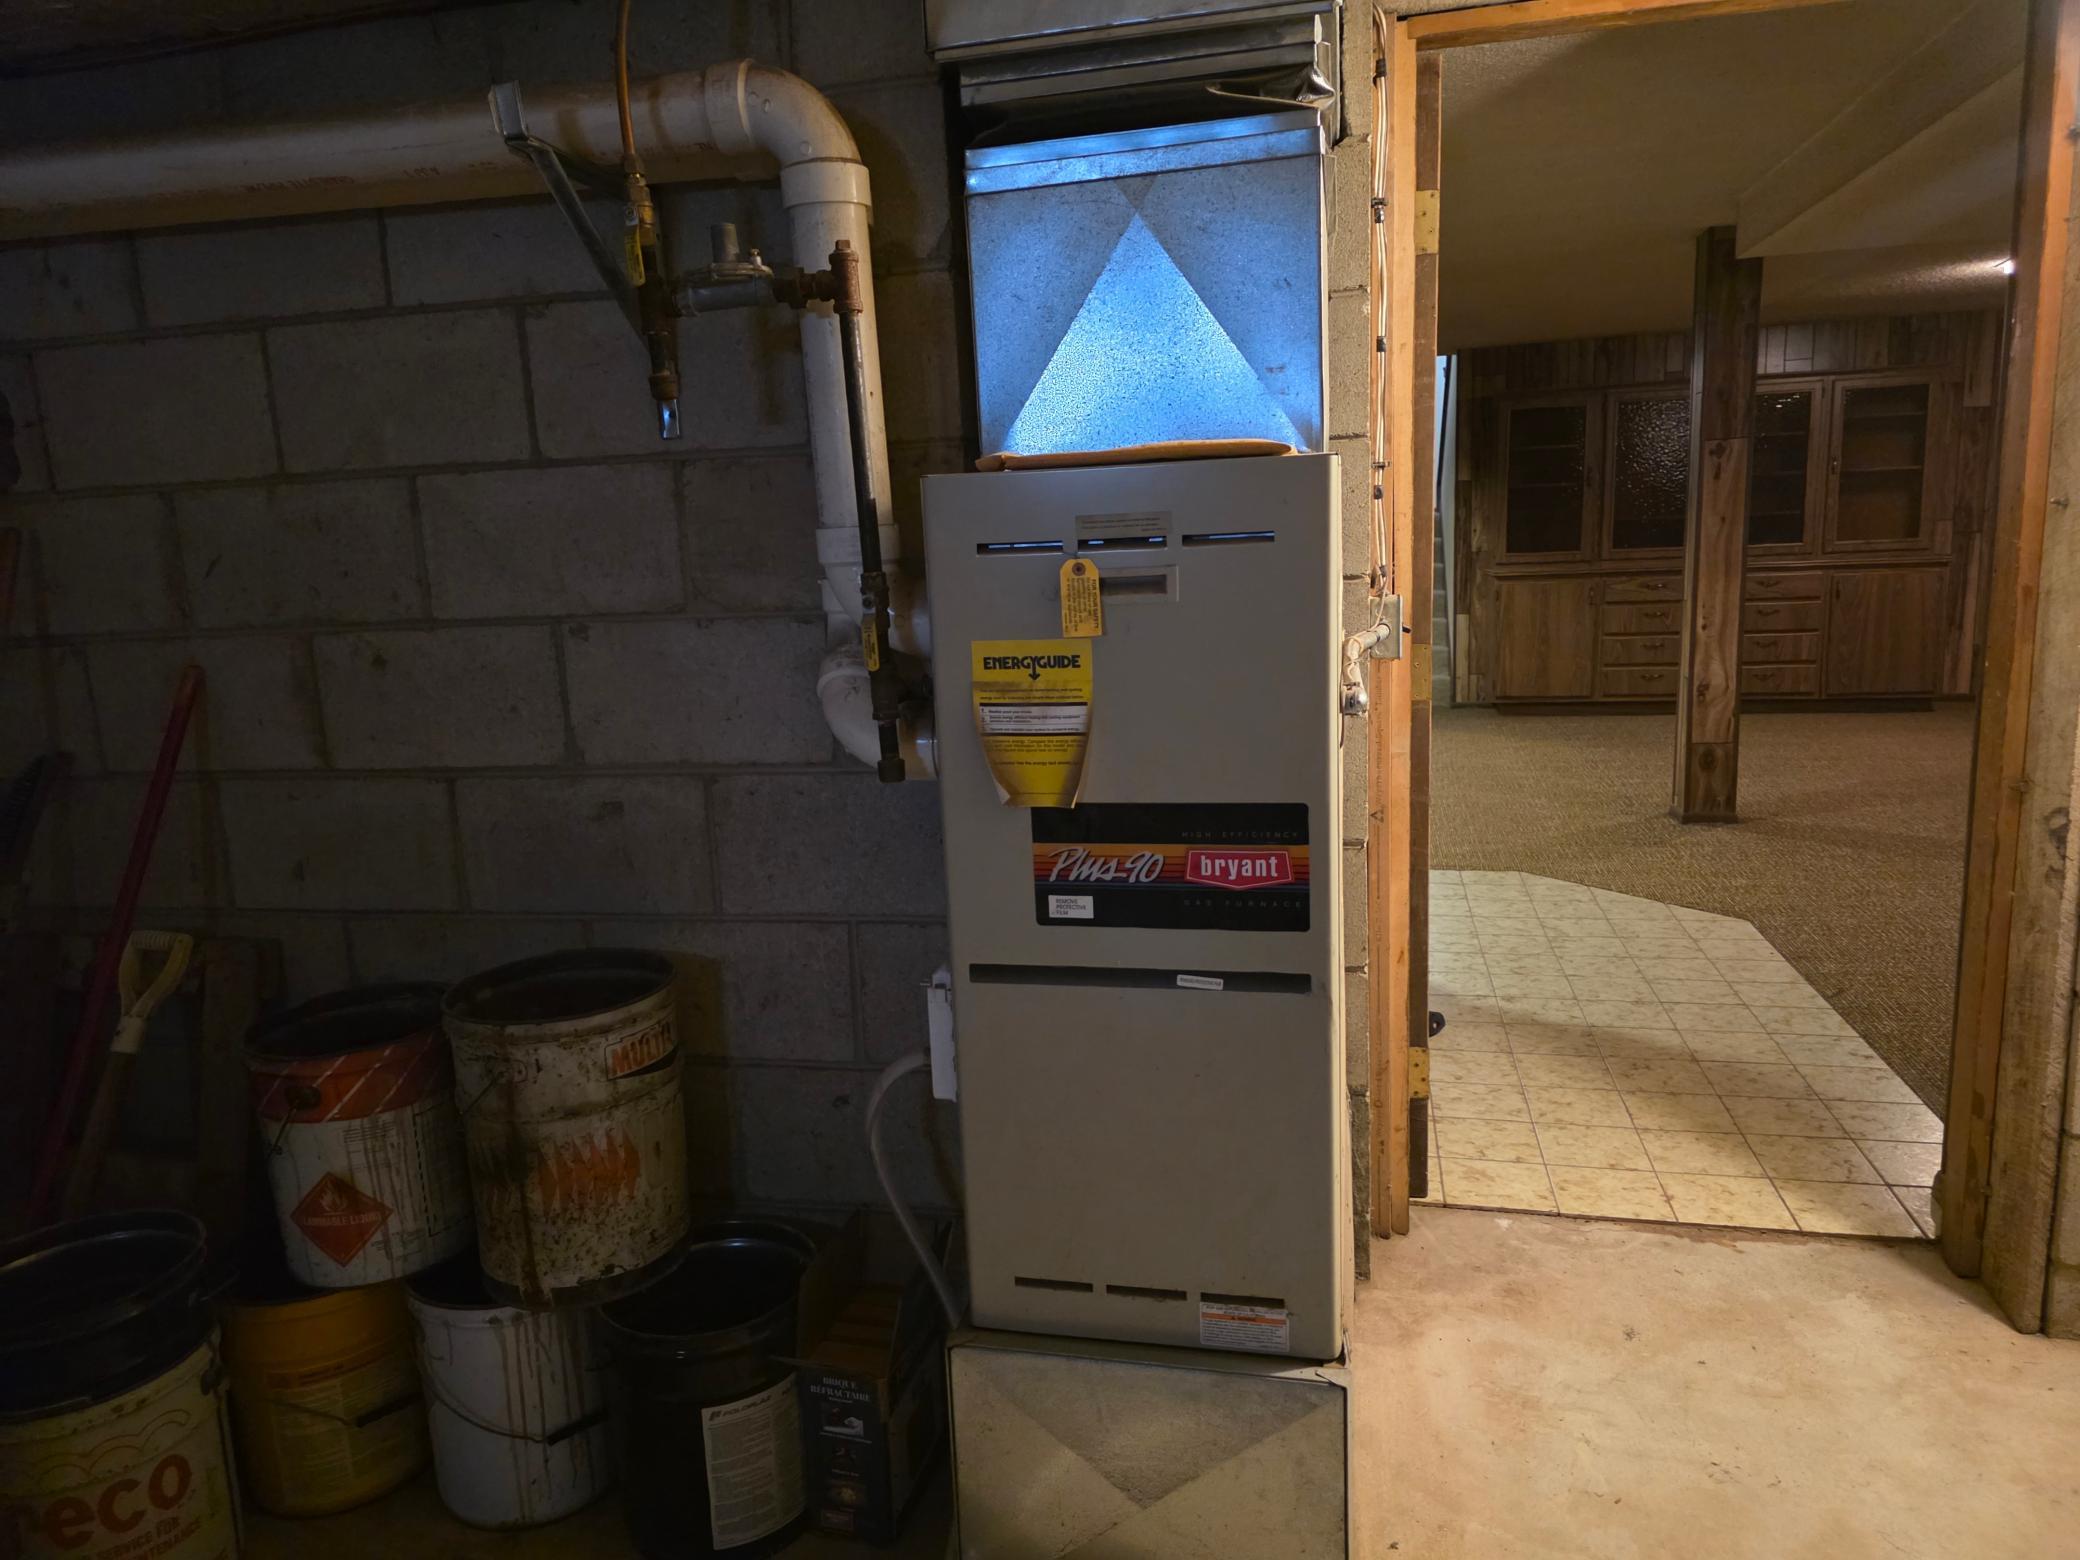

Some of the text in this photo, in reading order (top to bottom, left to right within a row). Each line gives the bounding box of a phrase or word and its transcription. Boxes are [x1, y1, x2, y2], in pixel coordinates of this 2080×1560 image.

[1181, 831, 1298, 839] HIGH EFFICIENCY
[1048, 846, 1165, 884] Plus 90
[1200, 855, 1279, 881] bryant
[1183, 899, 1304, 909] GAS FURNACE
[155, 1516, 181, 1539] FOR
